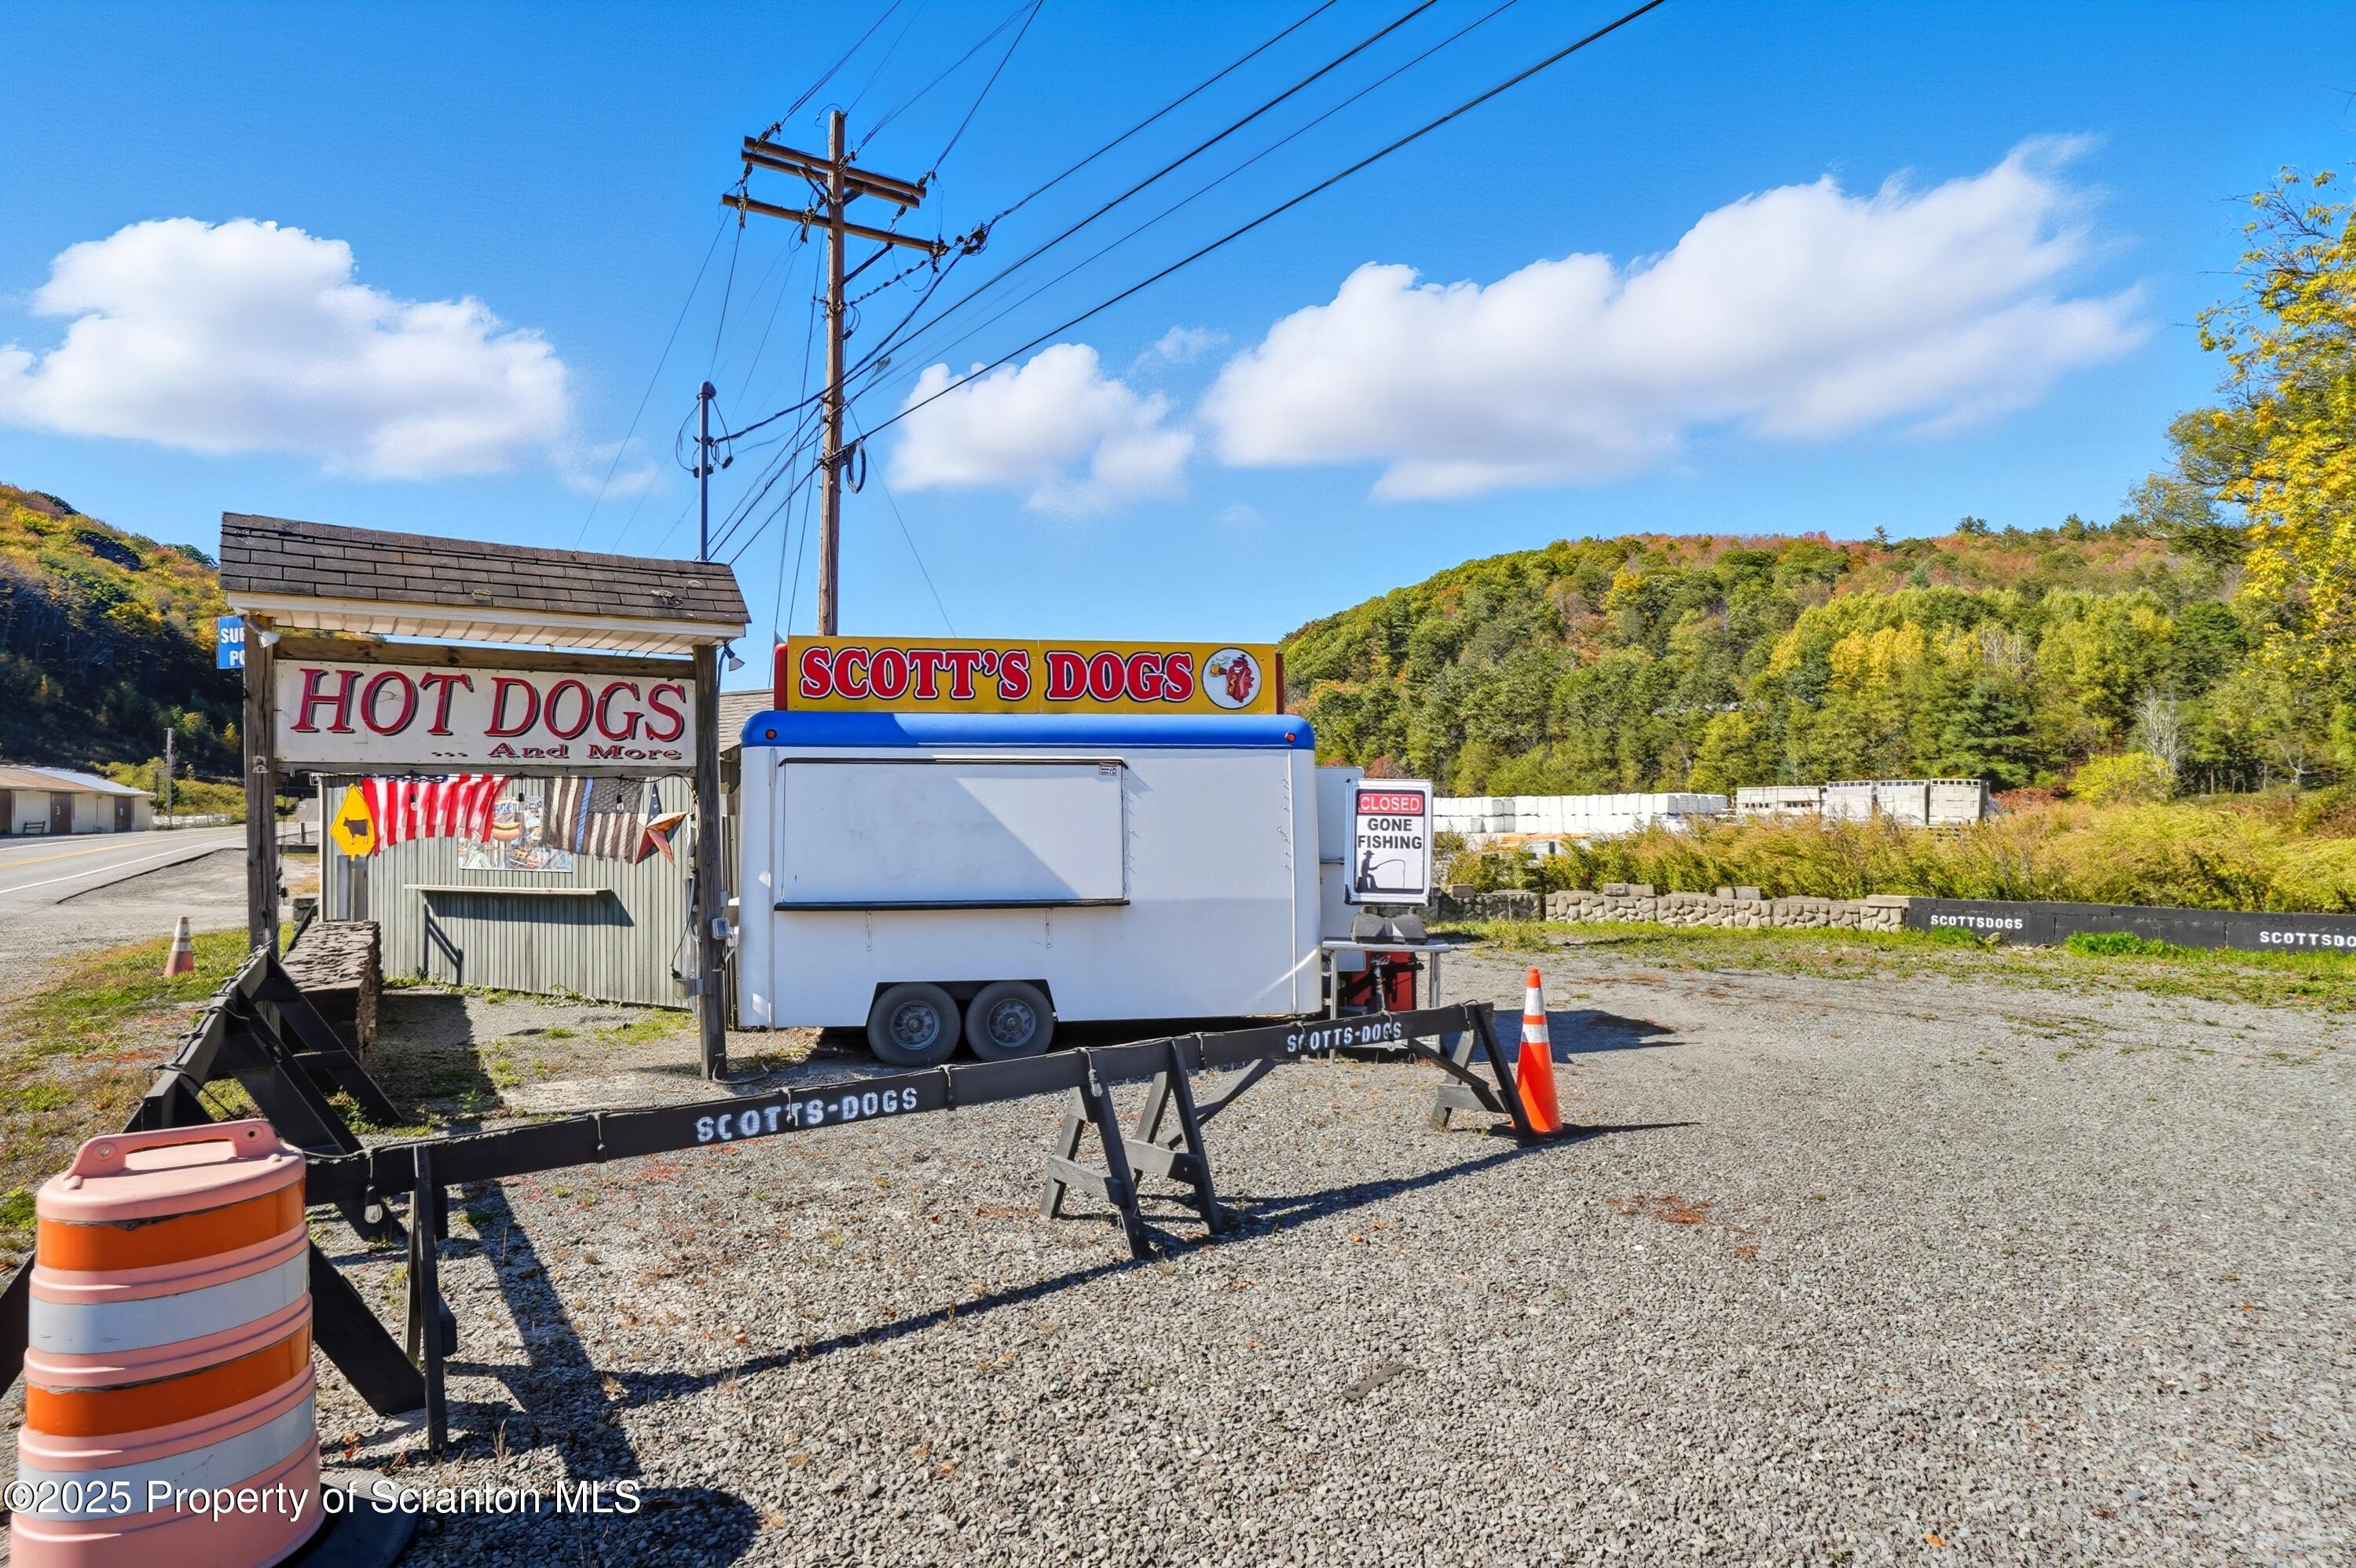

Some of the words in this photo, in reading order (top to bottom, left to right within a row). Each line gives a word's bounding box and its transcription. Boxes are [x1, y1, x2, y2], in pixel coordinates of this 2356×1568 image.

[800, 647, 1031, 701] SCOTT'S
[1045, 650, 1195, 703] DOGS
[291, 668, 474, 736] HOT
[484, 677, 687, 742] DOGS
[487, 742, 570, 760] And
[588, 744, 683, 760] More
[1360, 796, 1420, 812] CLOSED
[1367, 818, 1413, 832] GONE
[1358, 835, 1423, 850] FISHING
[1930, 914, 2024, 929] SCOTTSDOGS
